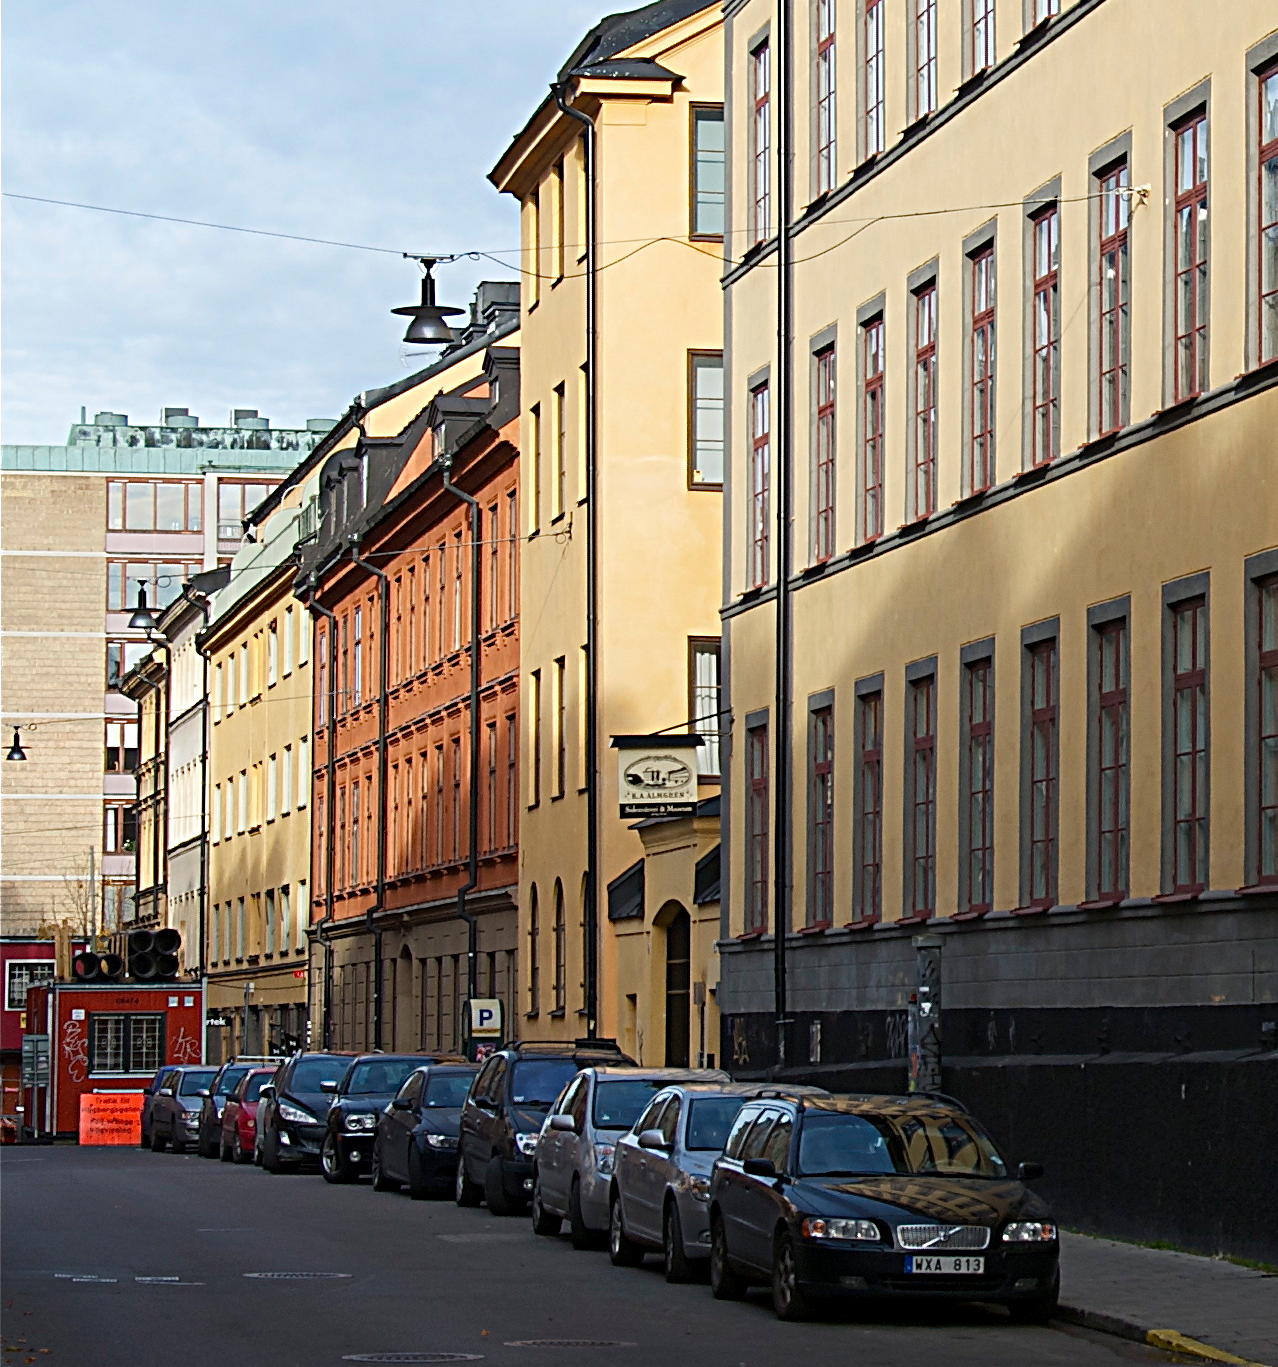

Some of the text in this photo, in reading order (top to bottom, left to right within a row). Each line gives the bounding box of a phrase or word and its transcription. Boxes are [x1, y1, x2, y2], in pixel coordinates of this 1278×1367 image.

[479, 1008, 493, 1026] P
[915, 1259, 981, 1272] WXA 813
